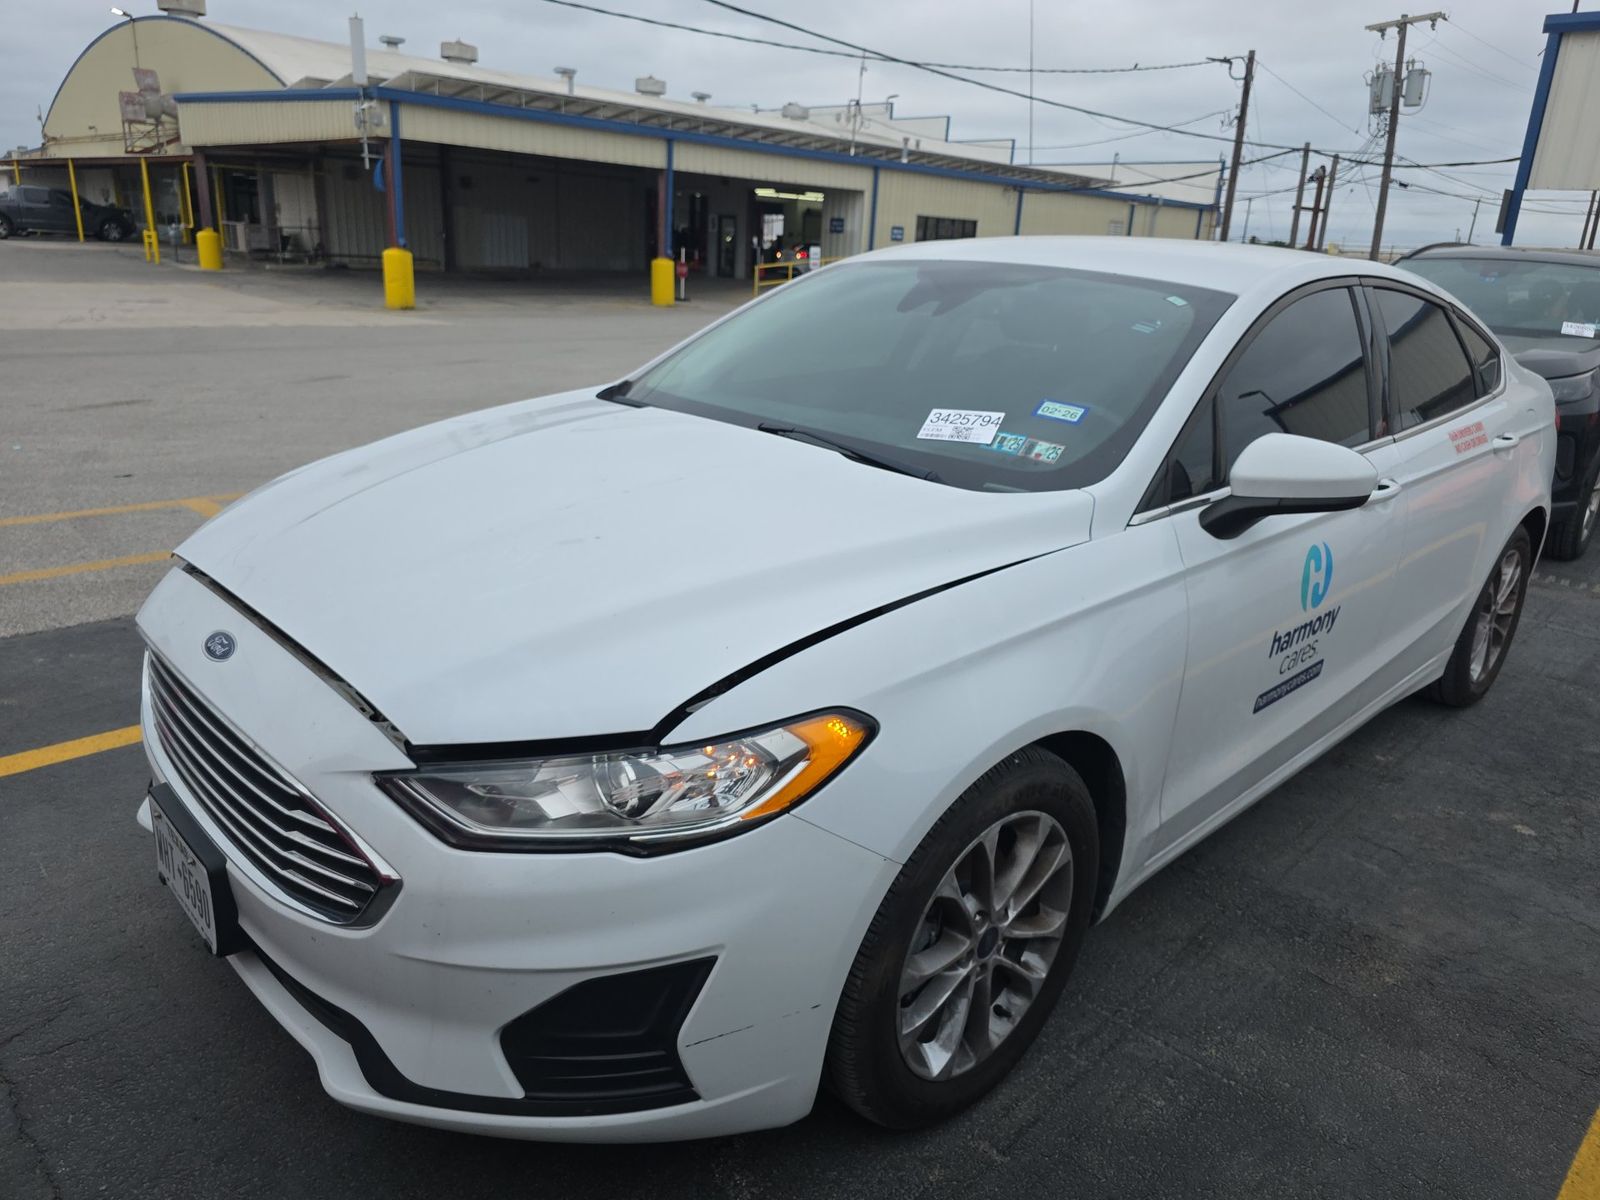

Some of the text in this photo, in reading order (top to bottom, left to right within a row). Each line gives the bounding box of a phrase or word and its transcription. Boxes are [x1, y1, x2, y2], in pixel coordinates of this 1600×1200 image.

[929, 411, 1002, 427] 3425794
[1269, 605, 1341, 659] harmony
[1279, 639, 1318, 675] cares
